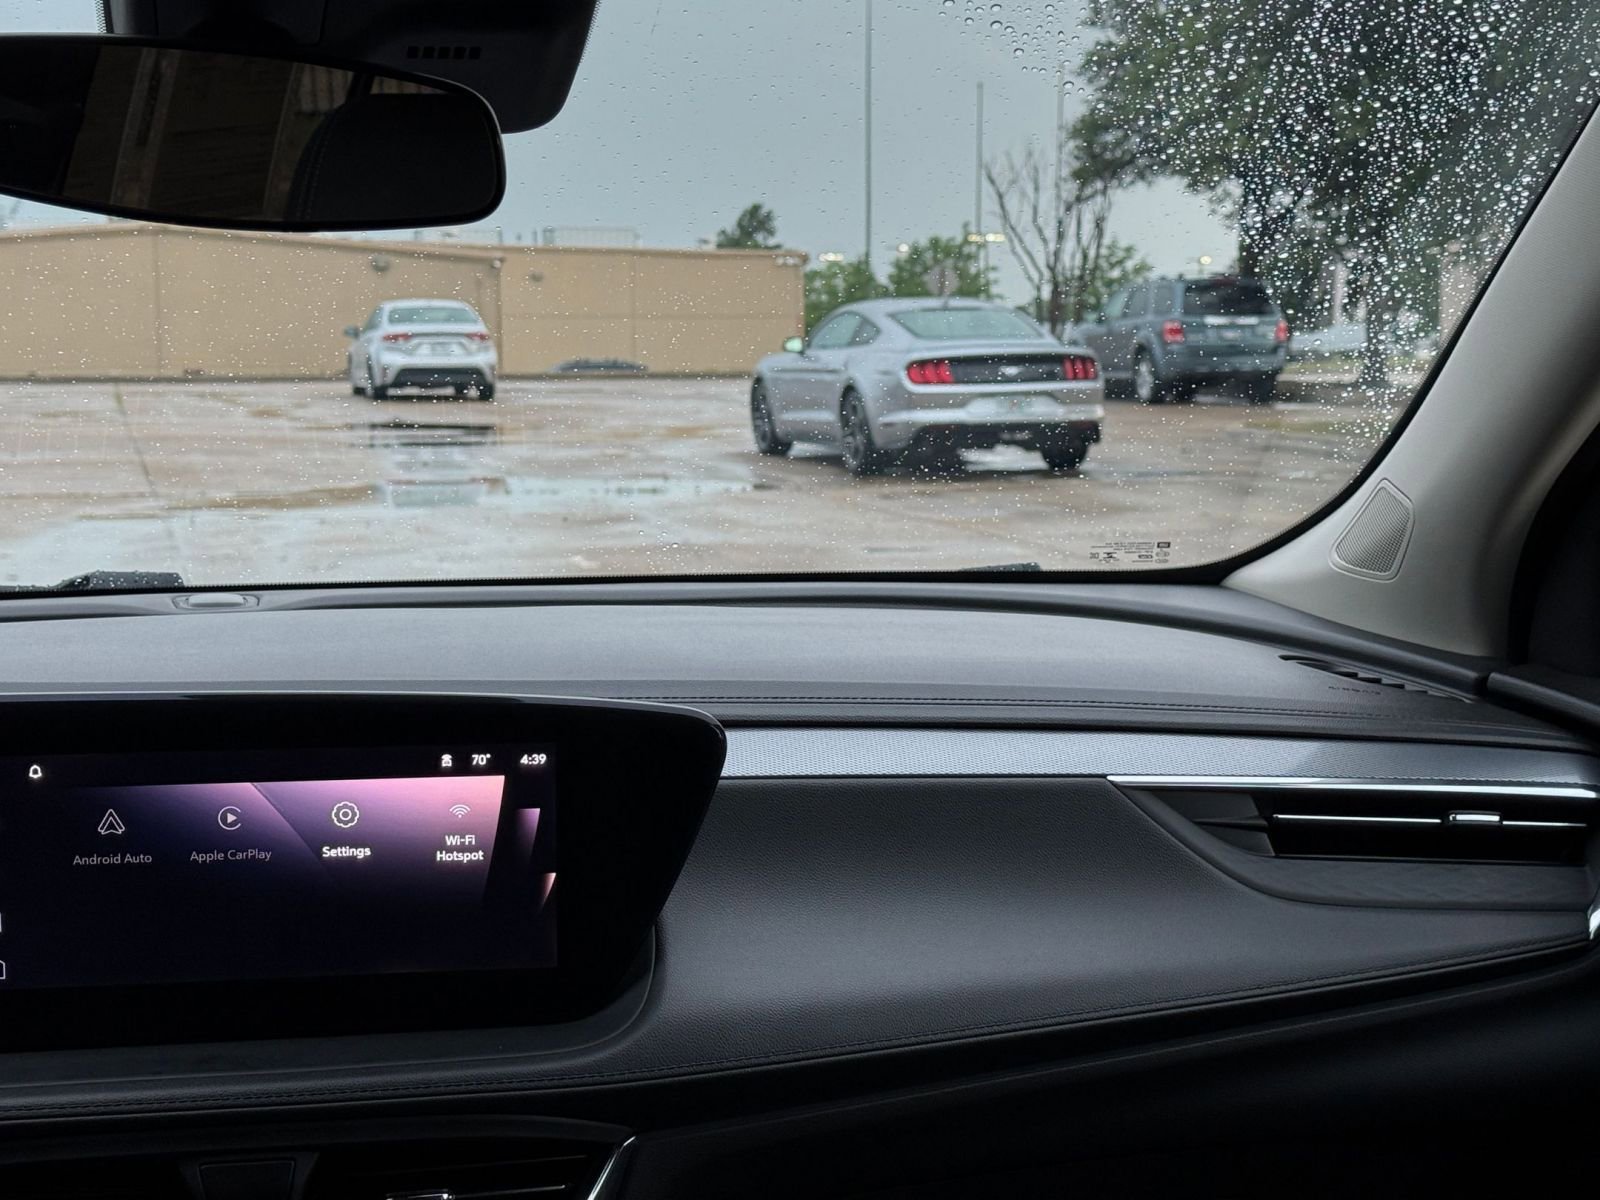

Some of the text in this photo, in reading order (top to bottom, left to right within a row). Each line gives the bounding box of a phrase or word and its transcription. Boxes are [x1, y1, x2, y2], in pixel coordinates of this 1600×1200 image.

[472, 754, 491, 766] 70°
[519, 753, 547, 765] 4:39
[445, 834, 476, 846] Wi-Fi
[189, 849, 272, 864] Apple CarPlay
[321, 846, 371, 859] Settings
[436, 850, 484, 863] Hotspot
[72, 853, 153, 866] Android Auto
